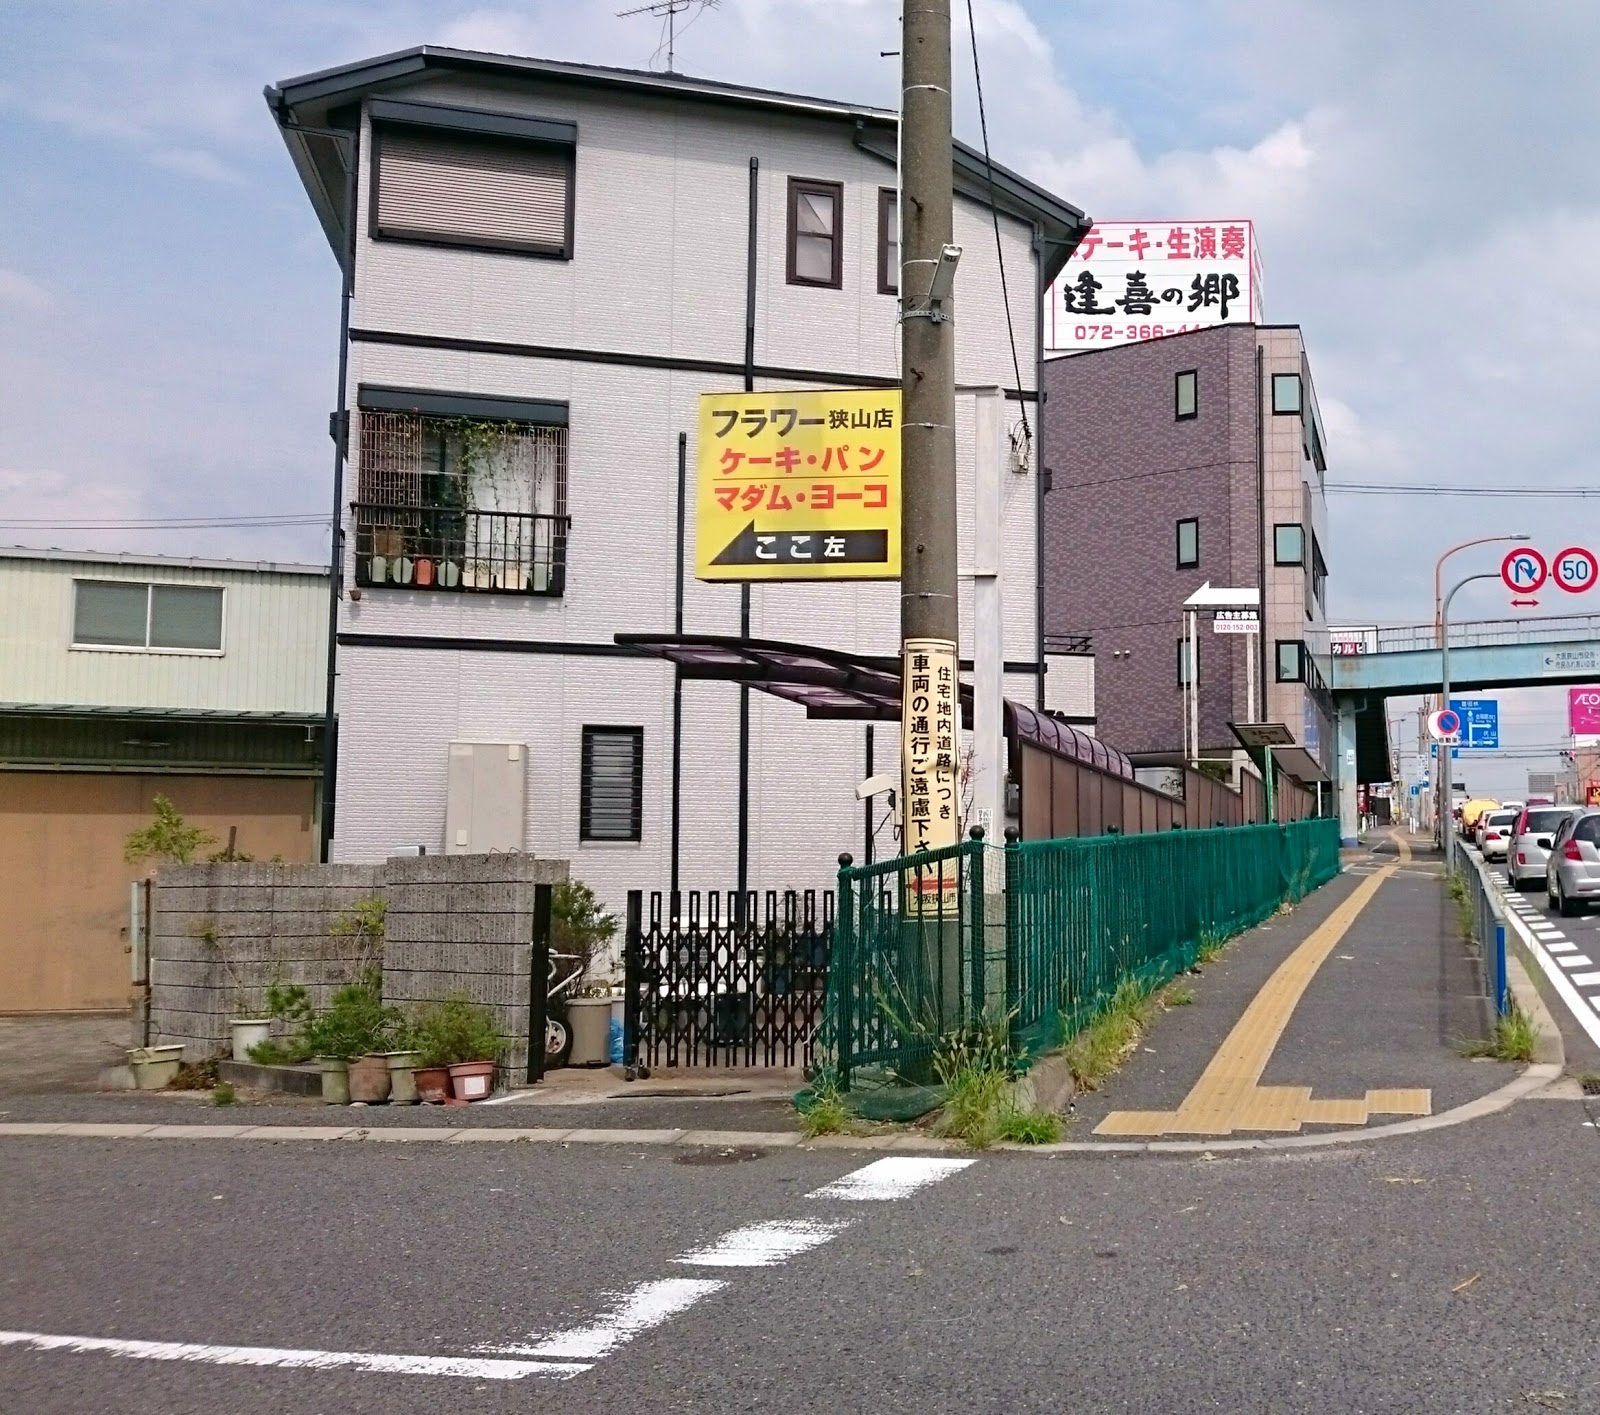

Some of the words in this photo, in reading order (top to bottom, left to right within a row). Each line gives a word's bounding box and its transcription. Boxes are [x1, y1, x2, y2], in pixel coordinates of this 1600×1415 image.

[1073, 226, 1245, 261] テーキ・生演奏
[1063, 270, 1240, 320] 逢喜の郷
[719, 444, 885, 475] ケーキ・パン
[714, 484, 888, 511] マダム・ヨーコ
[755, 535, 846, 559] ここ左
[1562, 560, 1588, 581] 50
[936, 666, 953, 820] 住宅地内道路につき
